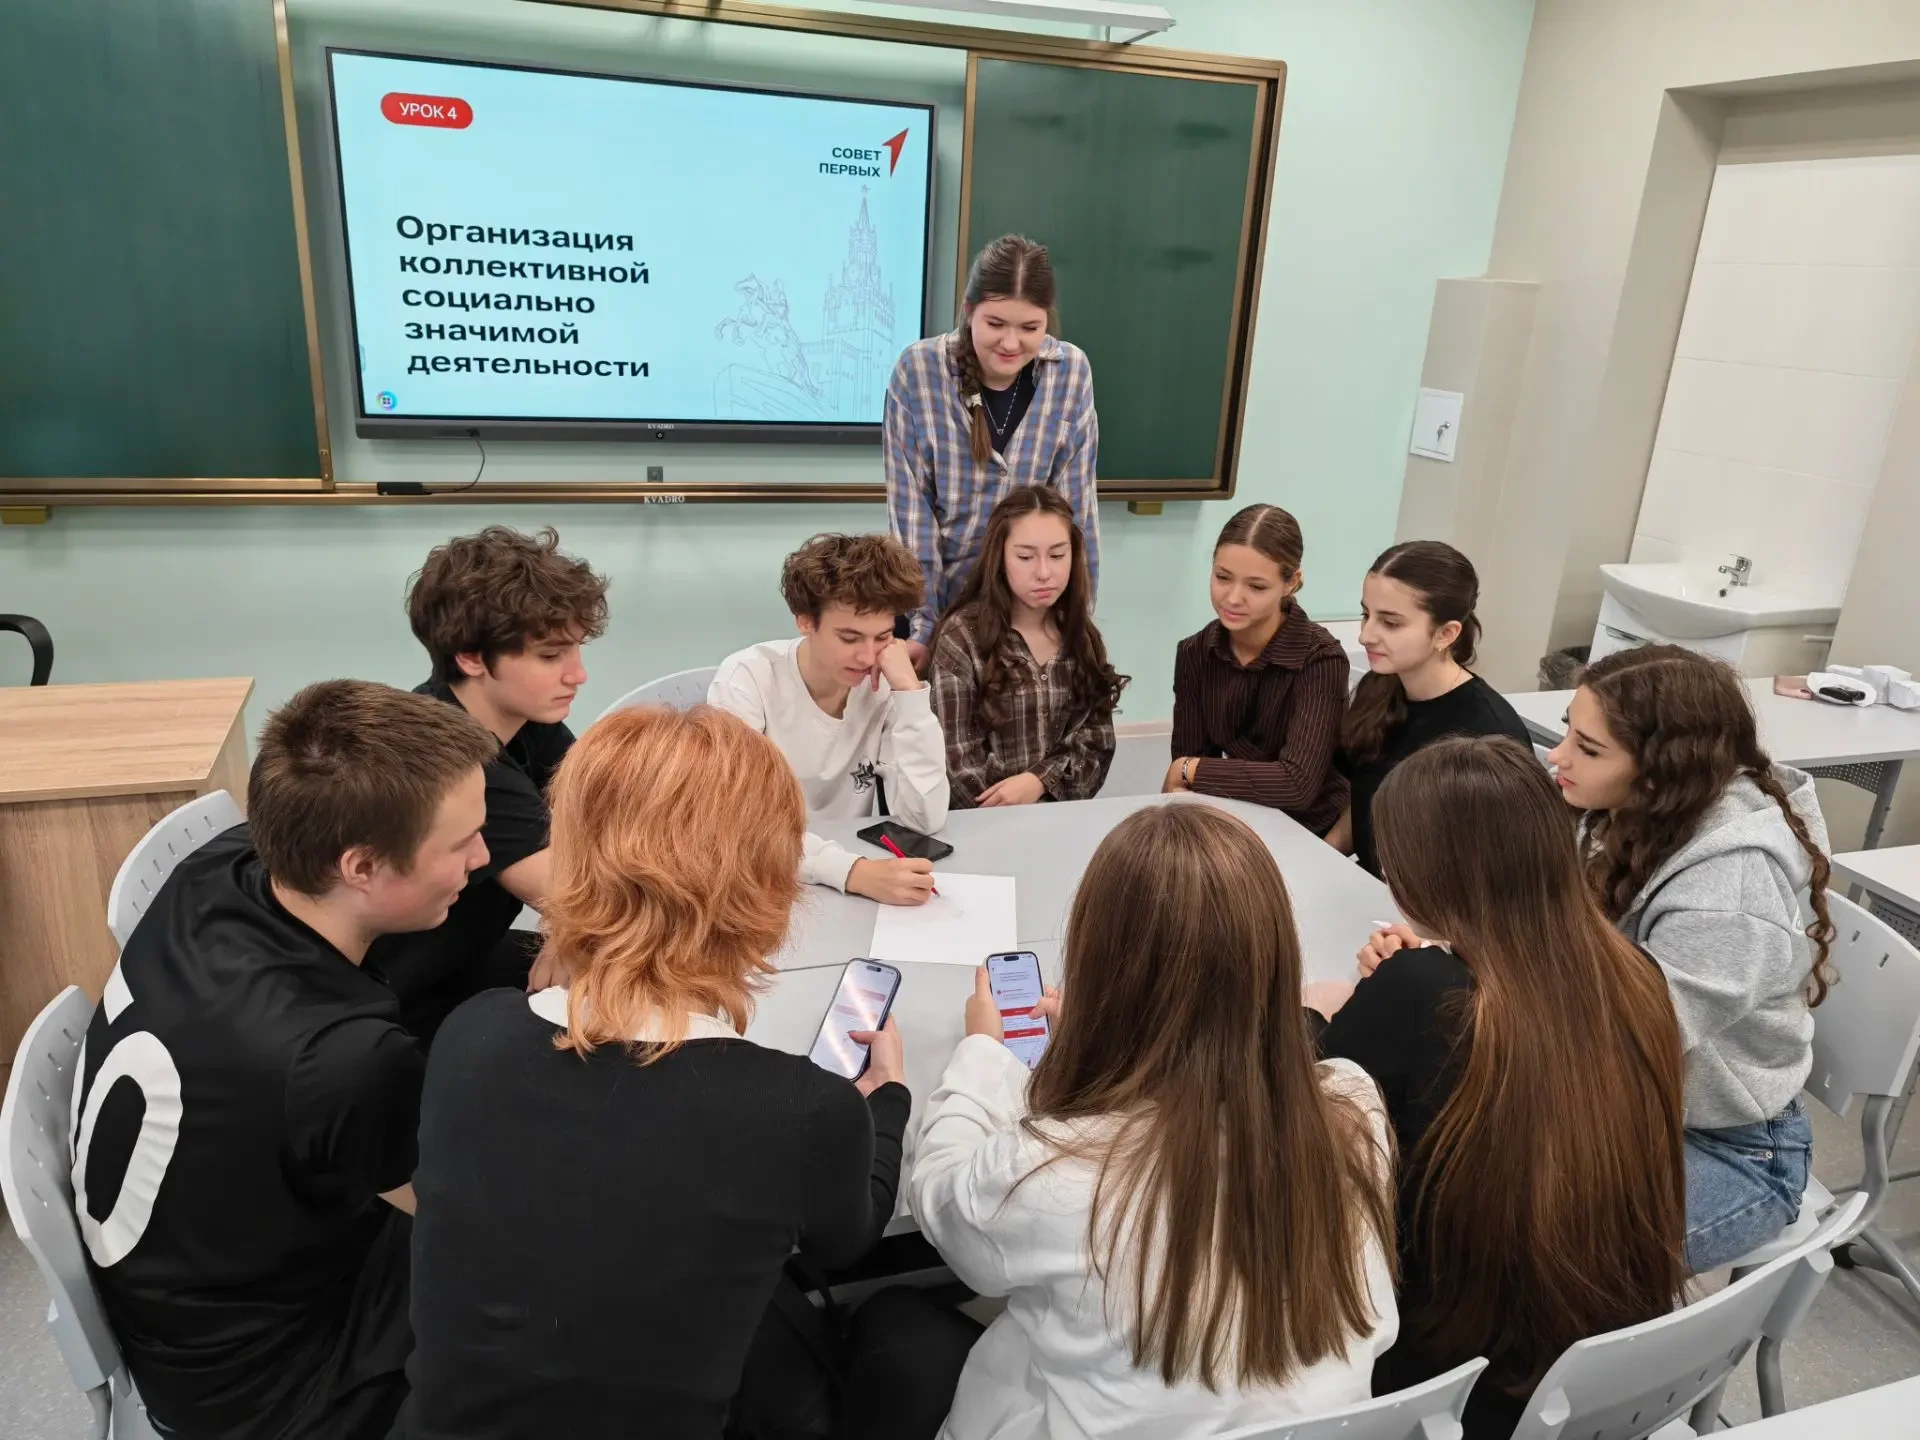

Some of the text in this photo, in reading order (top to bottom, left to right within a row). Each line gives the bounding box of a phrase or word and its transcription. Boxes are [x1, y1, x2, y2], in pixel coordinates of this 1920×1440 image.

[399, 102, 457, 120] УРОК 4
[832, 147, 882, 161] СОВЕТ
[819, 162, 881, 177] ПЕРВЫХ
[396, 215, 634, 254] Организация
[399, 255, 649, 284] коллективной
[402, 289, 596, 313] социально
[404, 322, 579, 345] значимой
[407, 355, 649, 378] деятельности
[643, 495, 685, 504] KVADRO
